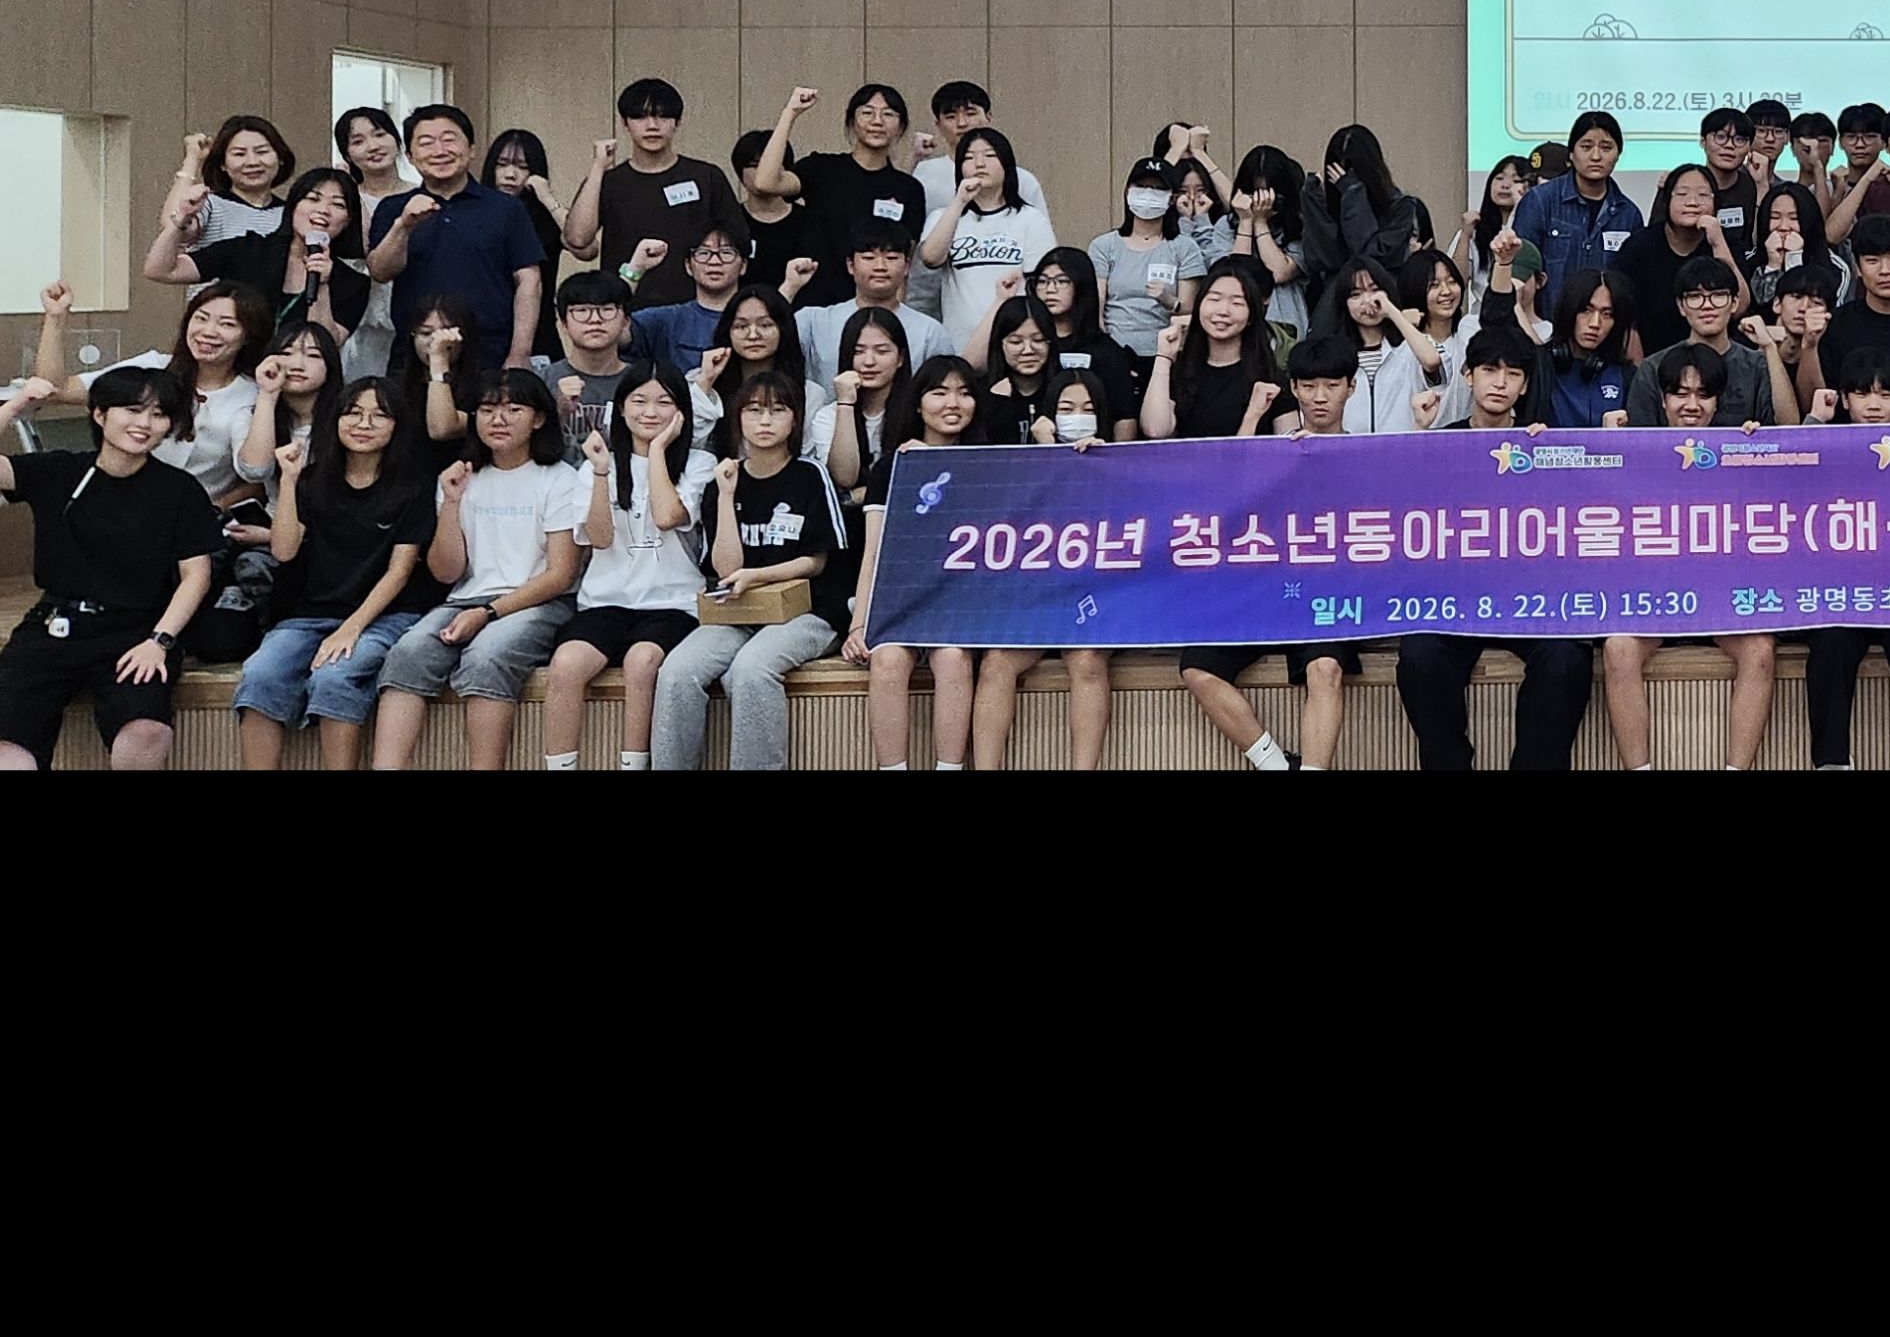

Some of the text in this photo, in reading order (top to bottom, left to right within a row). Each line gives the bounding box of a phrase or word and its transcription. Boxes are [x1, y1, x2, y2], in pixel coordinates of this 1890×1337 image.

[1576, 91, 1716, 112] 2026.8.22.(토)
[951, 235, 1024, 264] Boston
[943, 518, 1146, 570] 2026년
[1311, 595, 1364, 626] 일시
[1386, 596, 1467, 622] 2026.
[1476, 596, 1503, 620] 8.
[1512, 591, 1608, 622] 22.(토)
[1620, 591, 1698, 617] 15:30
[1731, 587, 1785, 616] 장소
